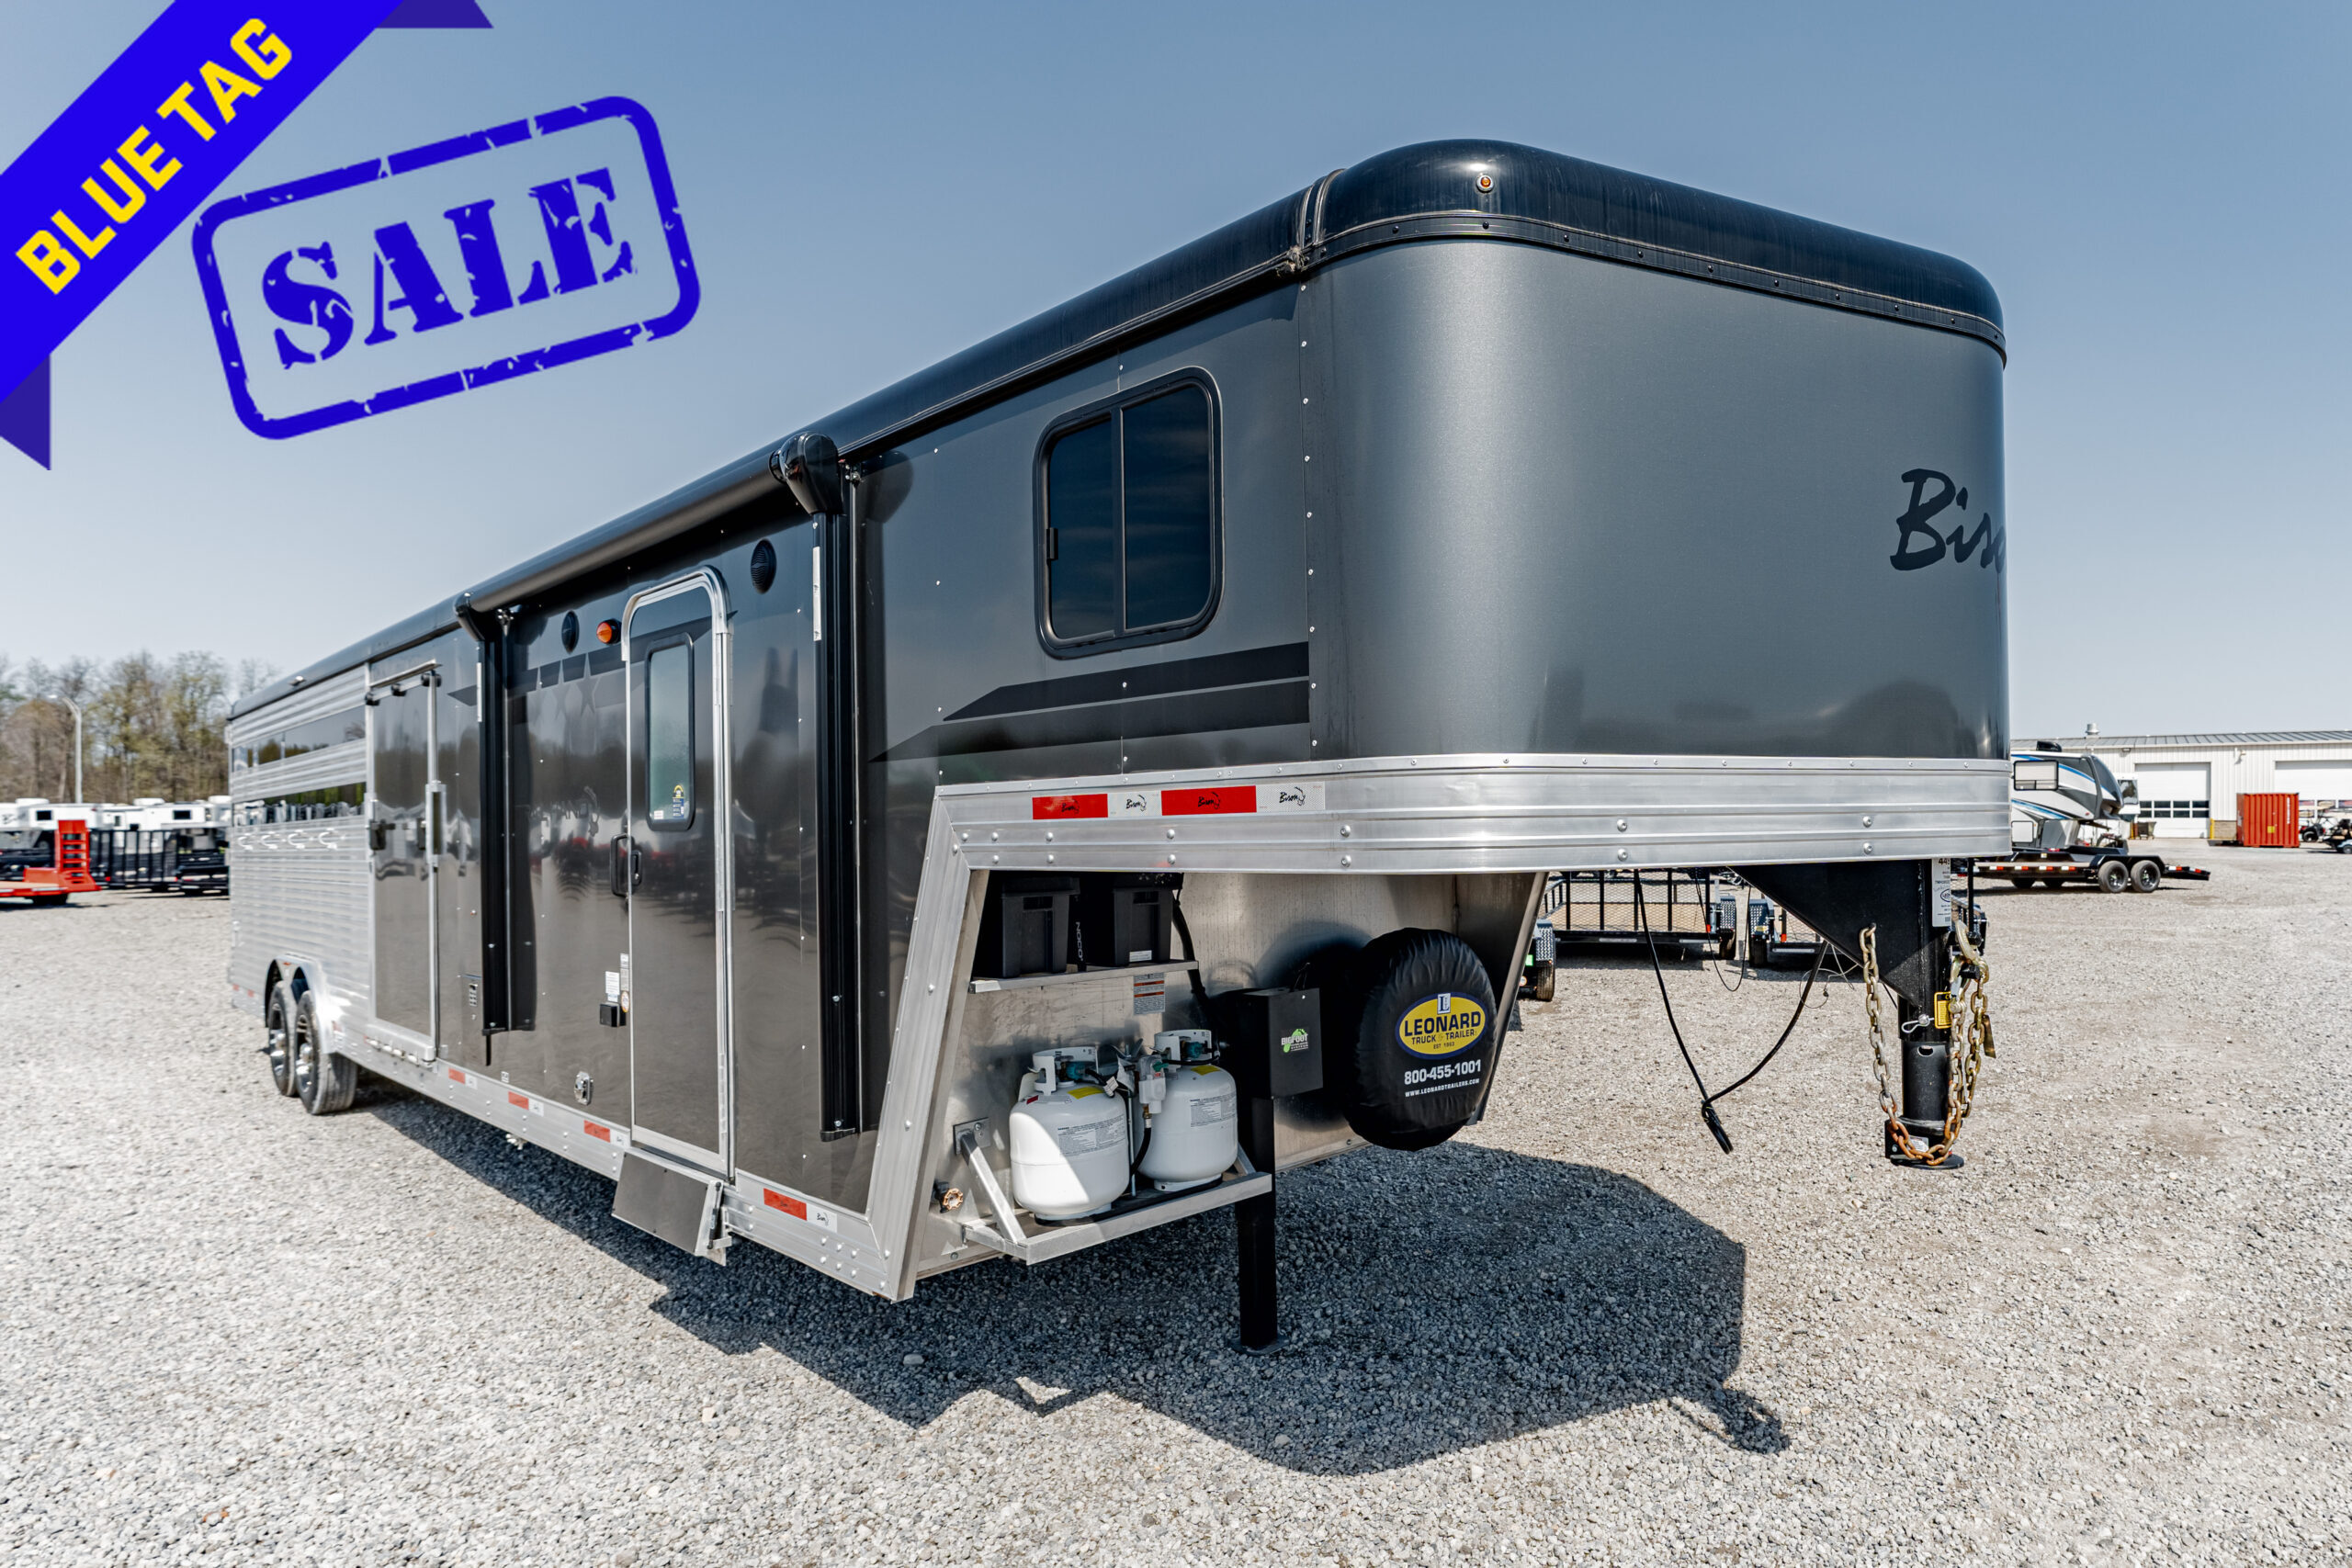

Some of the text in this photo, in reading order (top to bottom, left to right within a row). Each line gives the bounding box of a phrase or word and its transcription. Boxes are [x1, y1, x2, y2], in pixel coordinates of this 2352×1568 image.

[1404, 1011, 1481, 1037] LEONARD
[1411, 1034, 1437, 1045] TRUCK
[1445, 1029, 1475, 1041] TRAILER
[1404, 1059, 1481, 1085] 800-455-1001
